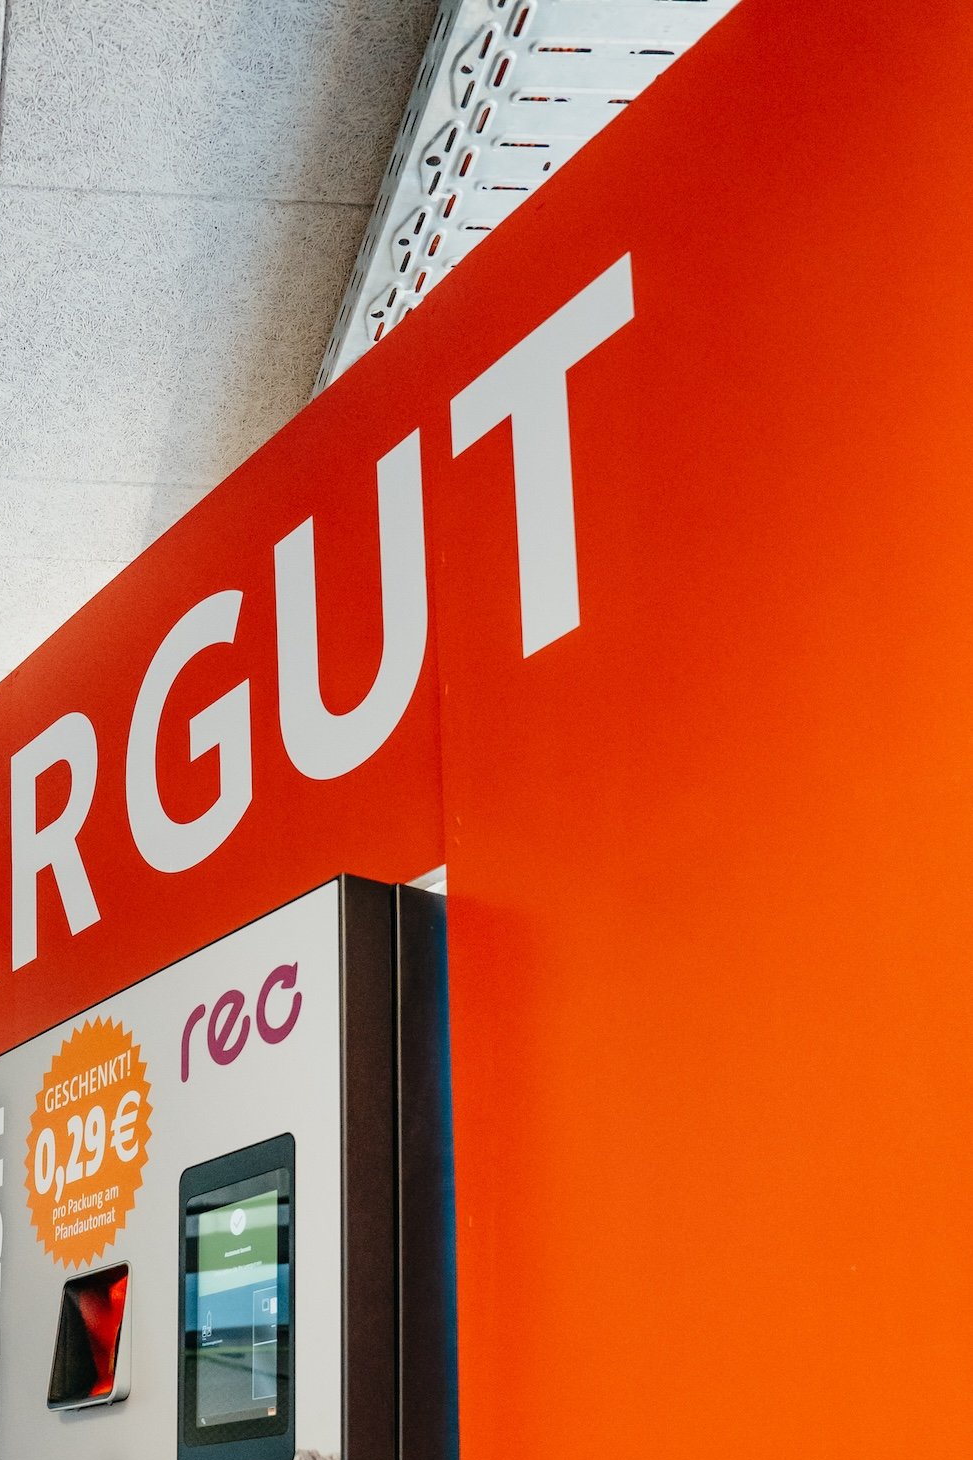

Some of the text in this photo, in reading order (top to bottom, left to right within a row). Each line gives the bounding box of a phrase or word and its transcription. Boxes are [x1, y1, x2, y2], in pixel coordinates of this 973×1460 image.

[179, 961, 303, 1083] rec
[44, 1049, 132, 1113] GESCHENKT!
[52, 1185, 120, 1225] pro Packung am
[54, 1207, 116, 1242] Pfandautomat
